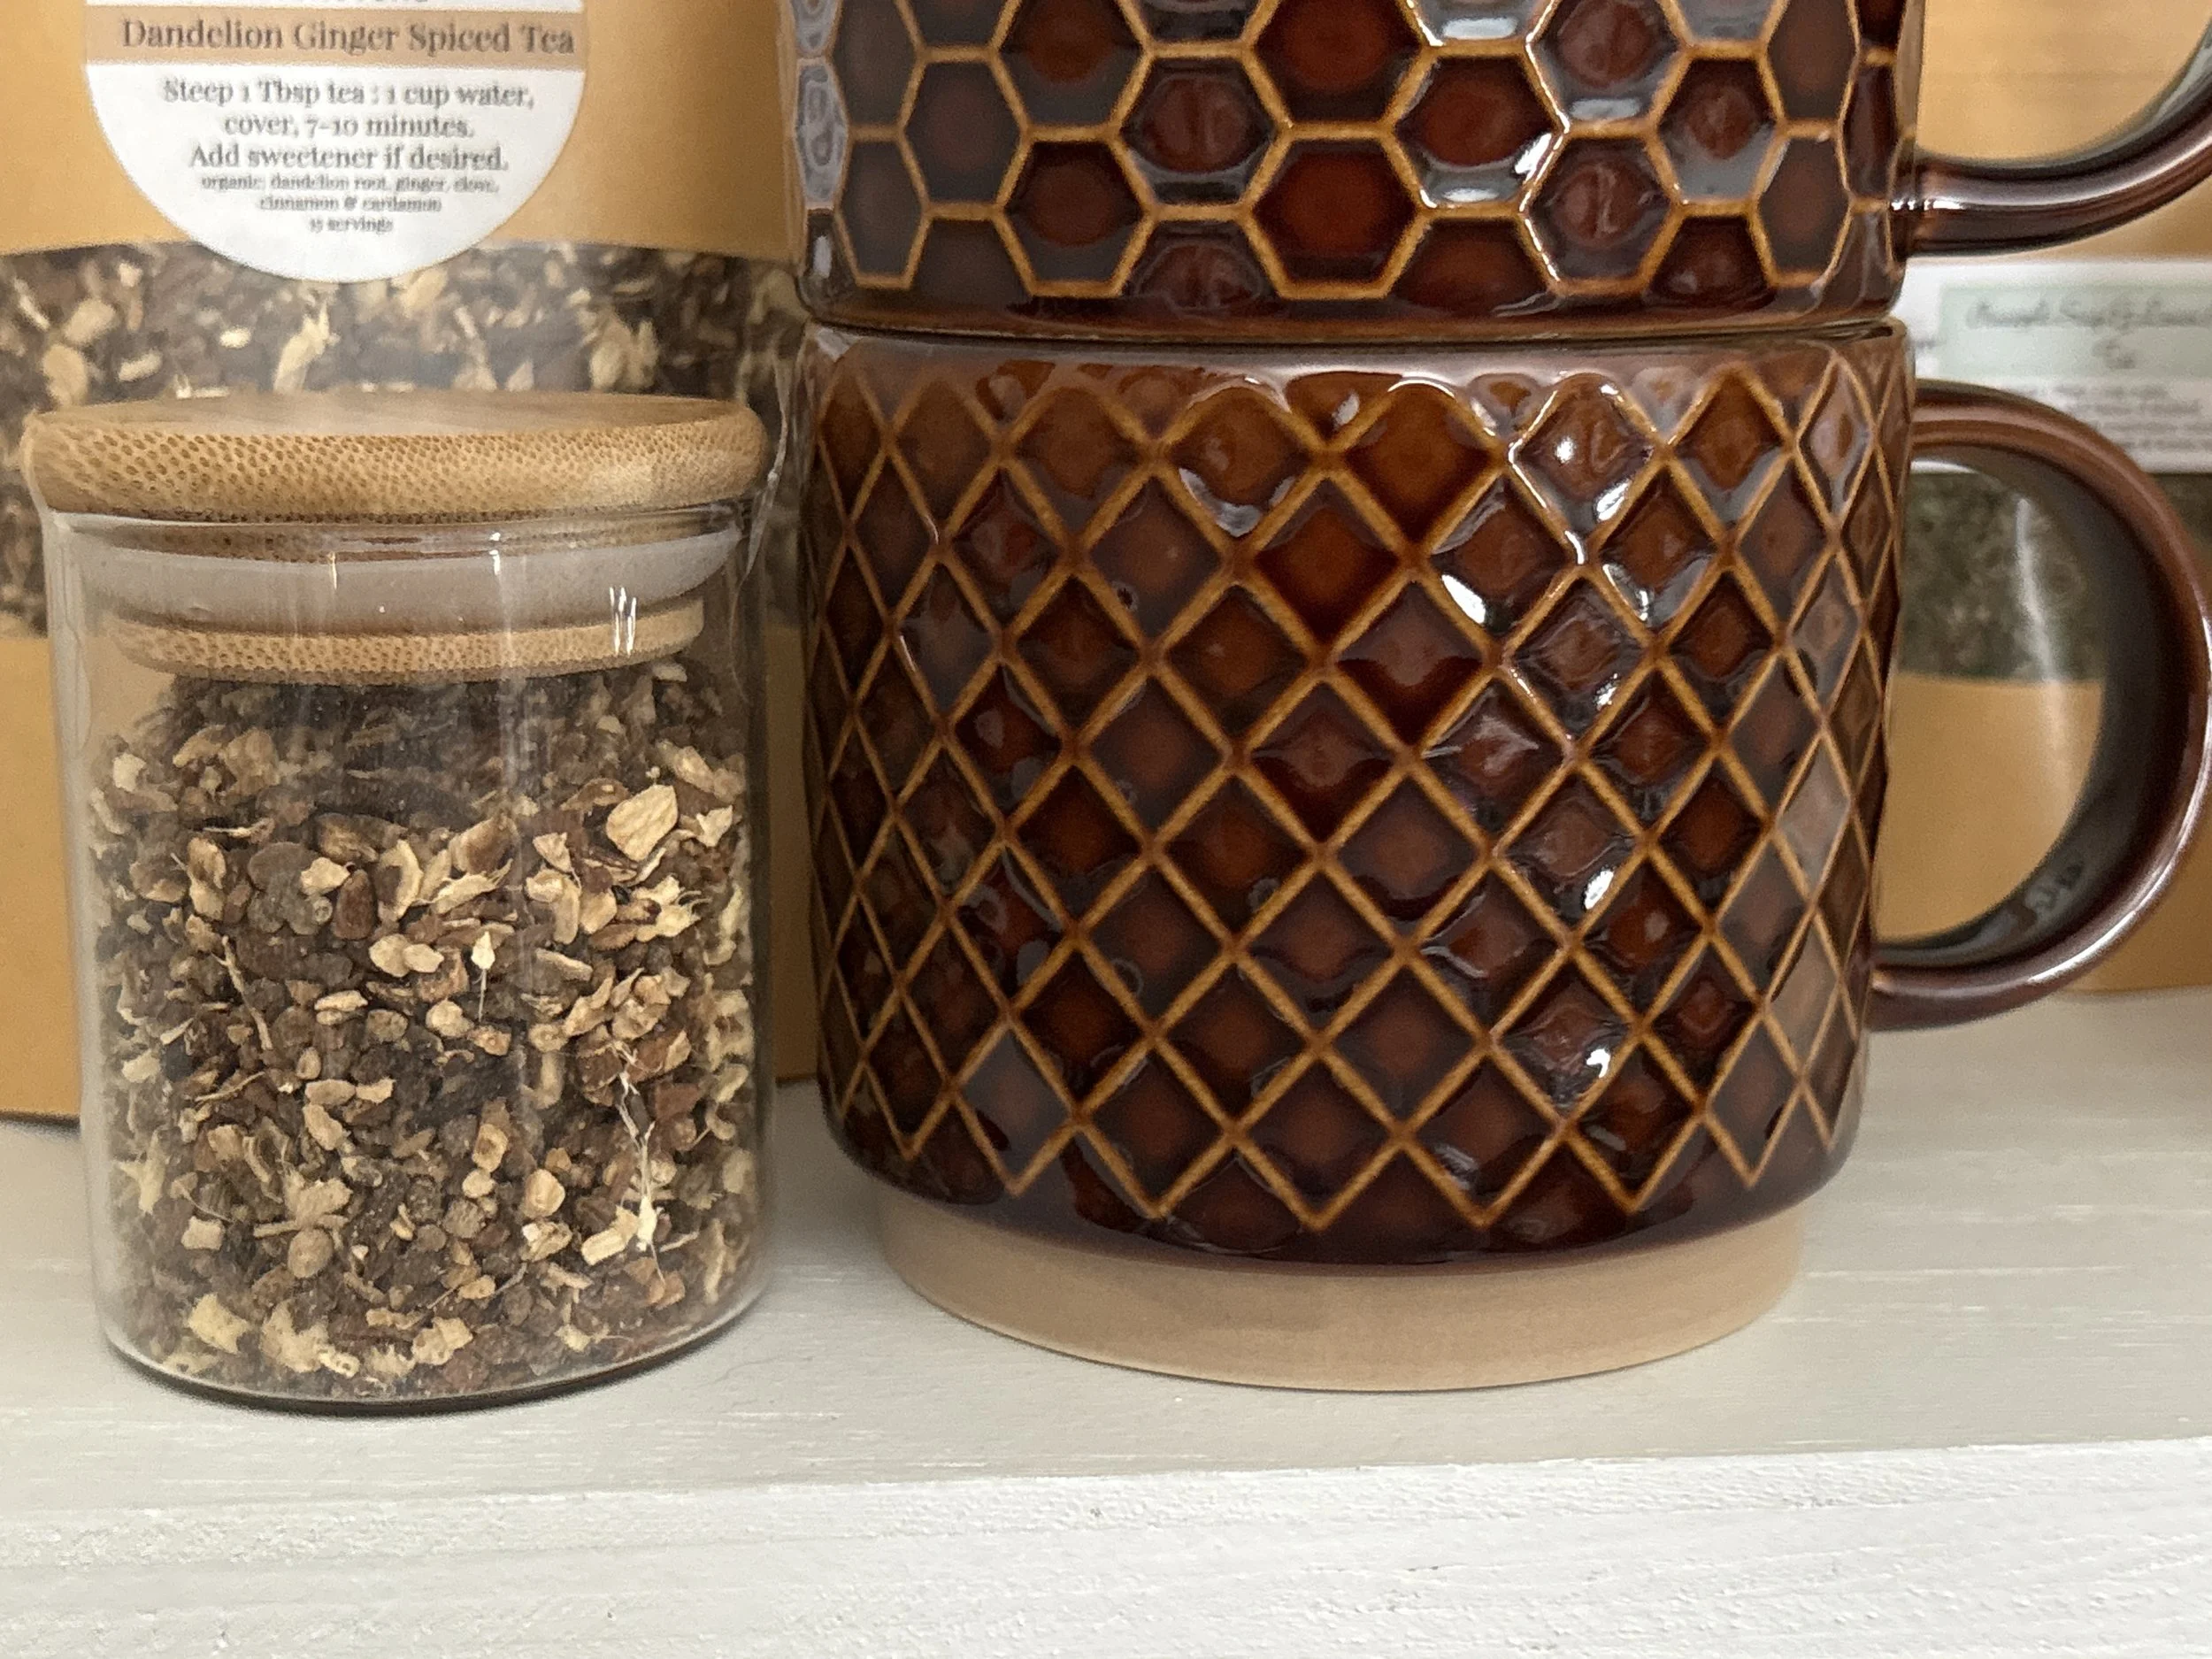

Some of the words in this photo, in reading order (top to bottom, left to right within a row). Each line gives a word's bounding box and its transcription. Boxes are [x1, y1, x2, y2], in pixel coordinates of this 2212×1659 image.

[123, 19, 283, 49] Dandelion
[294, 20, 398, 56] Ginger
[409, 22, 511, 58] Spiced
[520, 25, 574, 54] Tea
[164, 78, 234, 107] Steep
[257, 78, 320, 107] Tbsp
[328, 81, 365, 105] tea
[403, 86, 450, 109] cup
[455, 82, 534, 110] water,
[224, 114, 299, 137] cover,
[306, 117, 359, 139] 7-10
[188, 142, 240, 167] Add
[248, 145, 378, 169] sweetener
[384, 143, 403, 169] if
[409, 142, 510, 171] desired.
